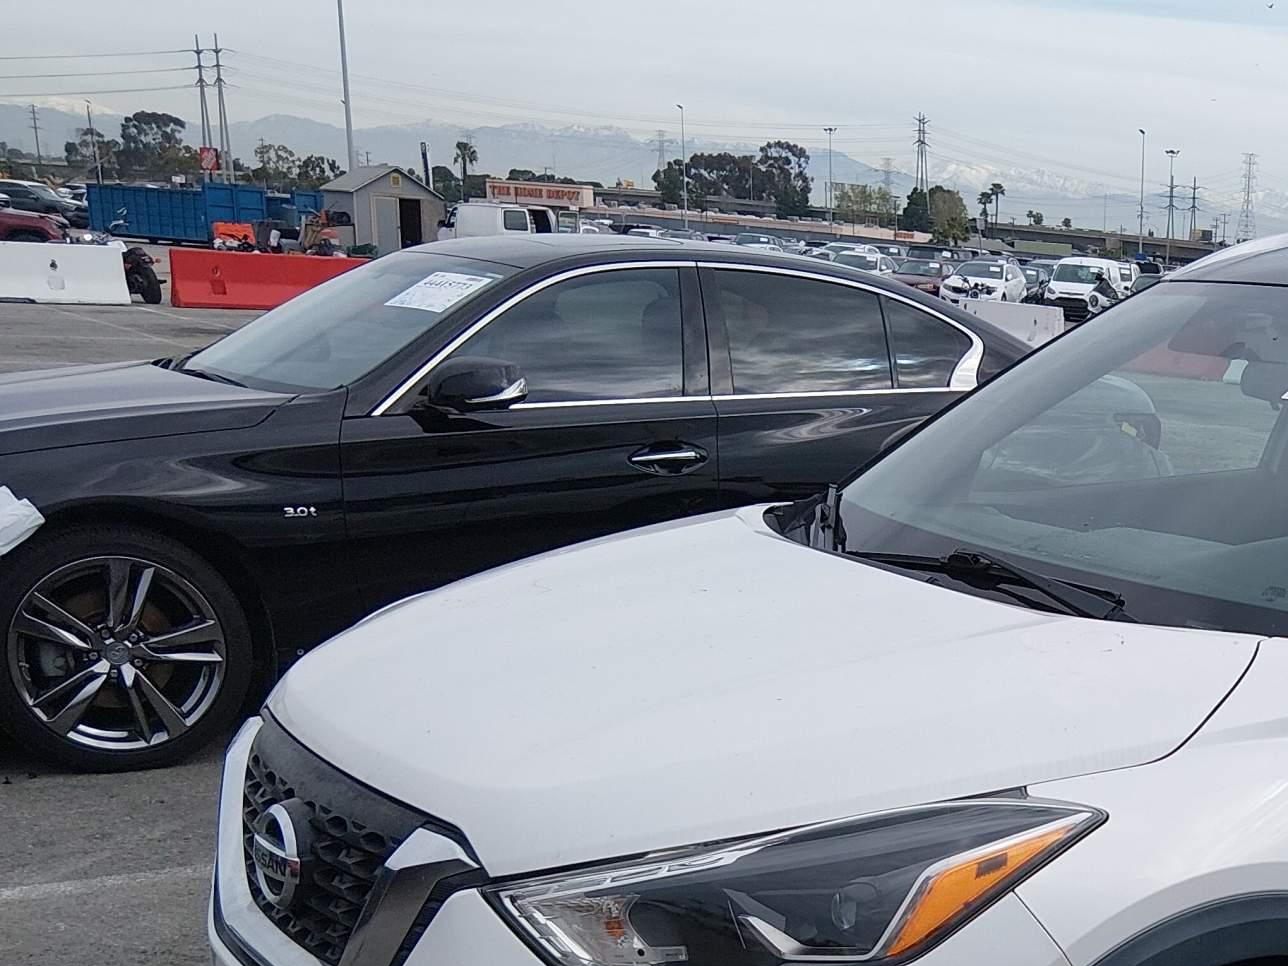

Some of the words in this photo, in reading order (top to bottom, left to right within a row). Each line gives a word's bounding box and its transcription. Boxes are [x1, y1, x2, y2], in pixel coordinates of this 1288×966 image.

[489, 185, 511, 196] THE
[546, 189, 580, 201] DEPOT
[283, 506, 317, 517] 3.0t
